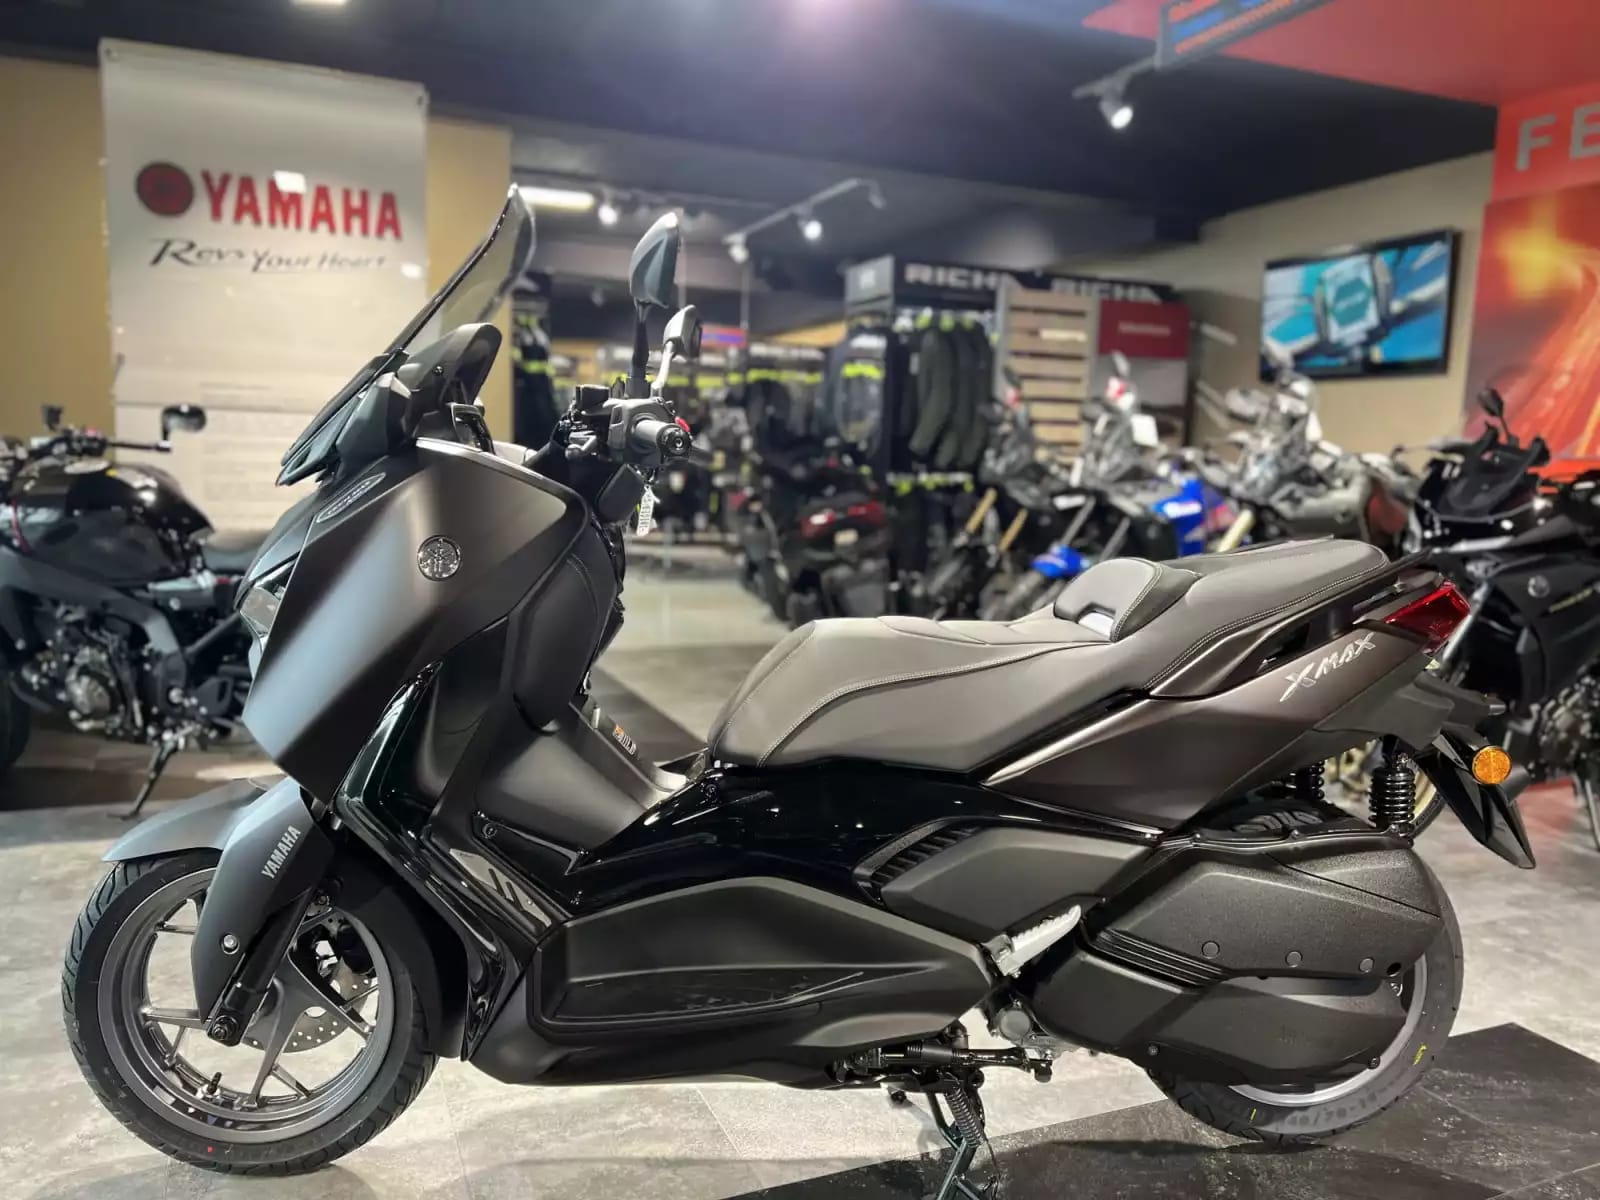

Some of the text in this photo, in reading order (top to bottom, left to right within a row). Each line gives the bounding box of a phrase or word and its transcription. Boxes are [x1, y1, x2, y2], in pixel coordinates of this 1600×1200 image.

[202, 169, 402, 240] YAMAHA
[252, 248, 310, 272] Your
[317, 250, 386, 269] Heart
[261, 825, 301, 879] YAMAHA
